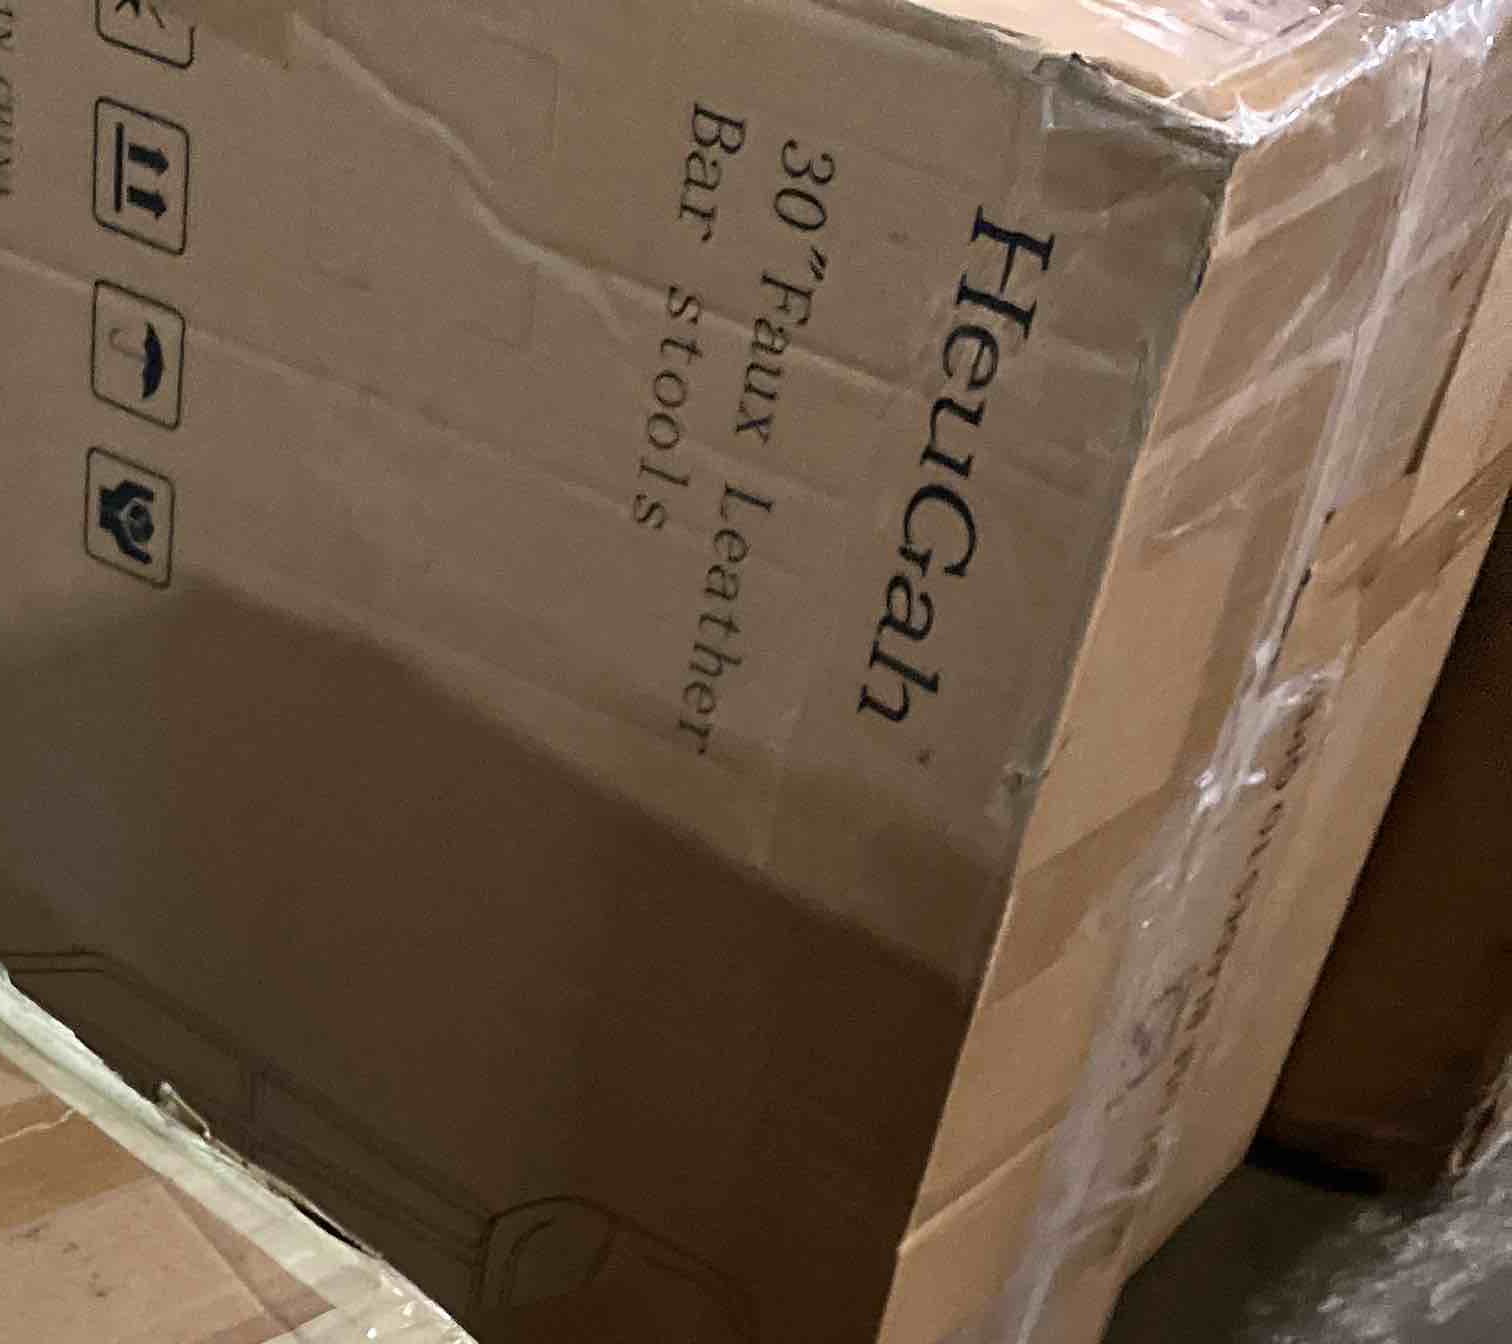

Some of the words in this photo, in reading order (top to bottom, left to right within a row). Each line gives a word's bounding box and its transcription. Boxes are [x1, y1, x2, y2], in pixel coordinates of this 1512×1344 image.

[678, 102, 747, 242] Bar
[632, 285, 704, 530] stools
[857, 205, 1055, 722] HeuGah
[678, 481, 774, 755] Leather
